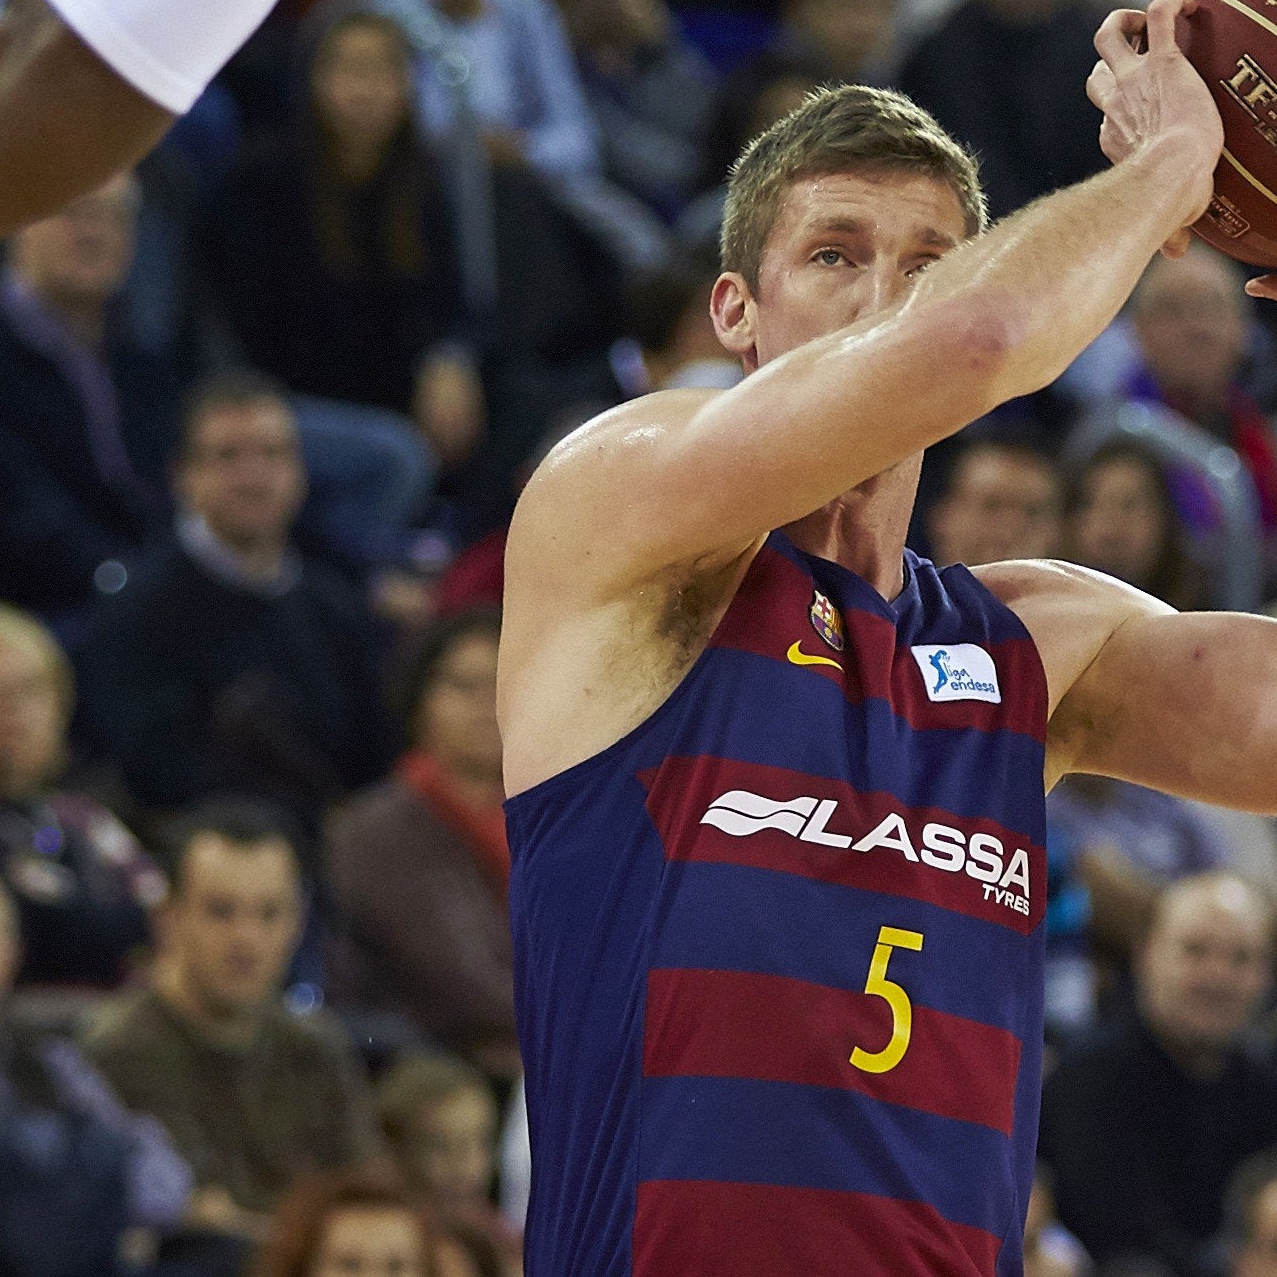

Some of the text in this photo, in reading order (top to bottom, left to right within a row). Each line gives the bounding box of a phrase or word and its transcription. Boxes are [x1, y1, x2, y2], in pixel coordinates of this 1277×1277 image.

[943, 662, 971, 681] liga
[950, 679, 997, 695] endesa
[799, 799, 1031, 899] LASSA
[981, 882, 1031, 917] TYRES
[848, 925, 924, 1075] 5
